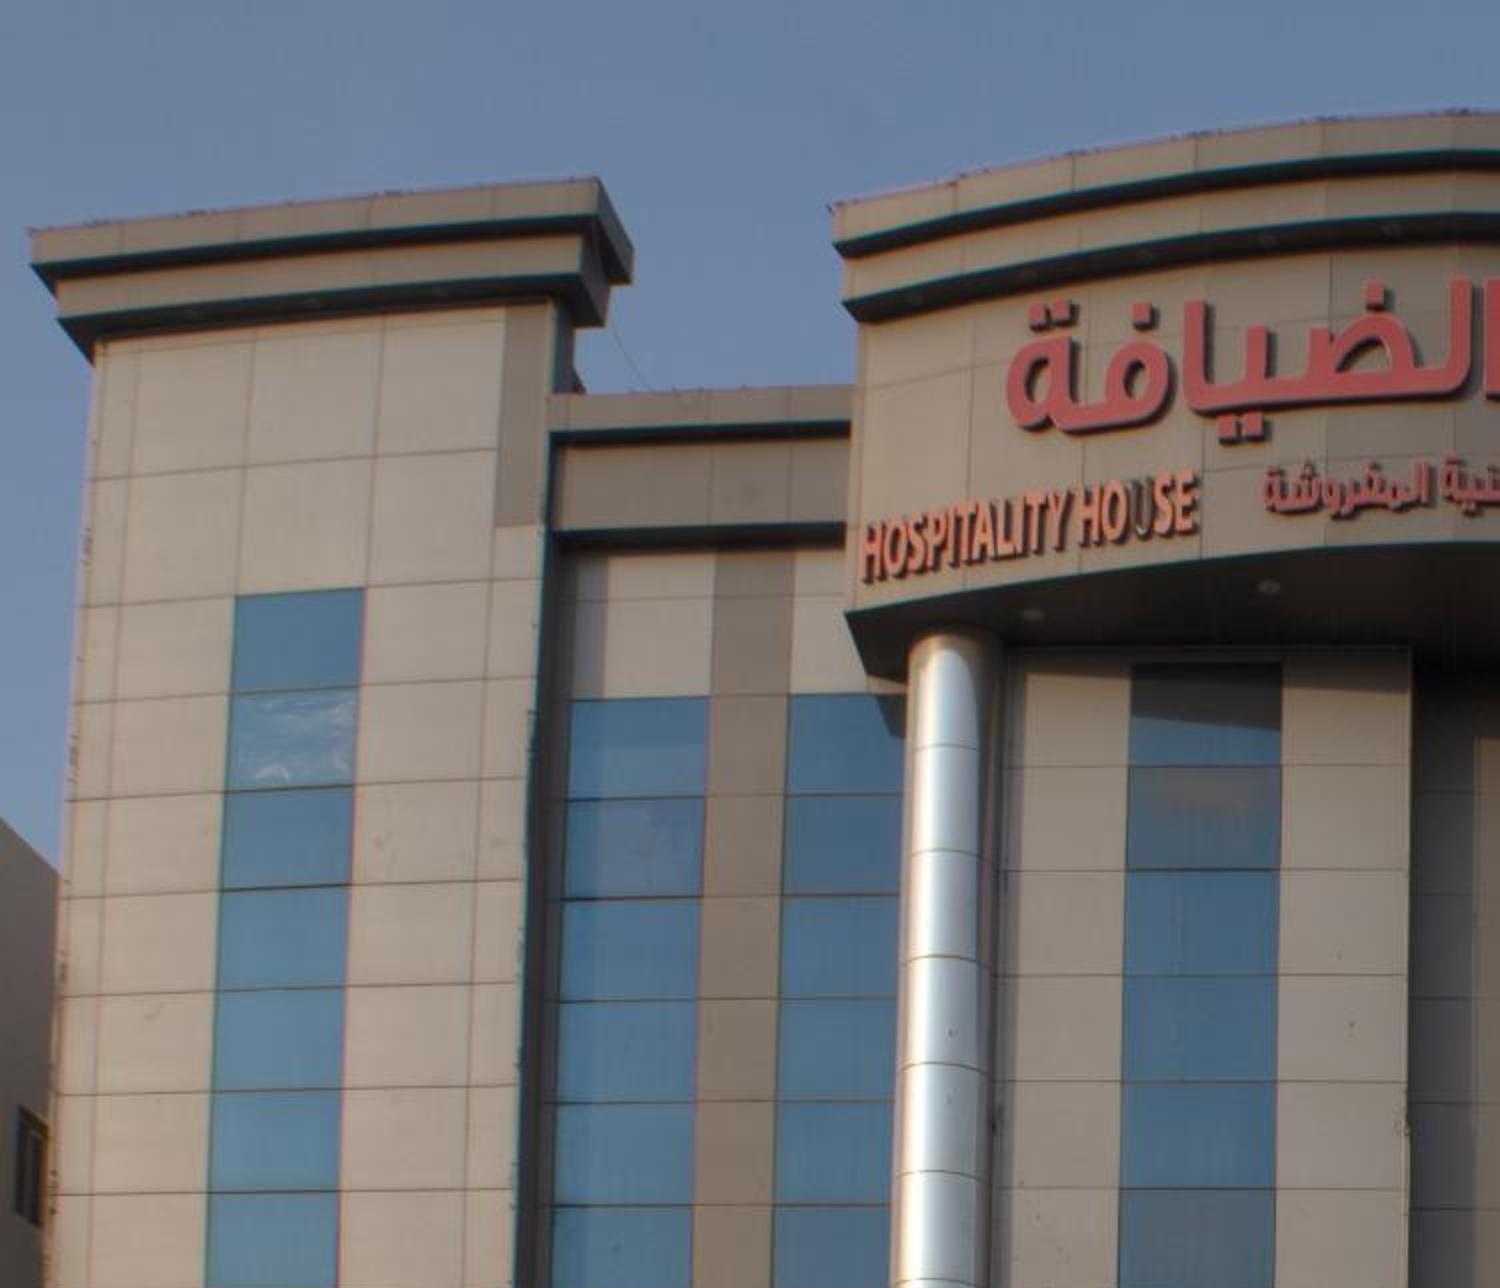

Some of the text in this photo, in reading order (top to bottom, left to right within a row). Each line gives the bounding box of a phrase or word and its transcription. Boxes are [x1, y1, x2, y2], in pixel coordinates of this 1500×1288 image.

[861, 467, 1198, 583] HOSPITALITY HOUSE
[1263, 460, 1430, 518] المفروشة
